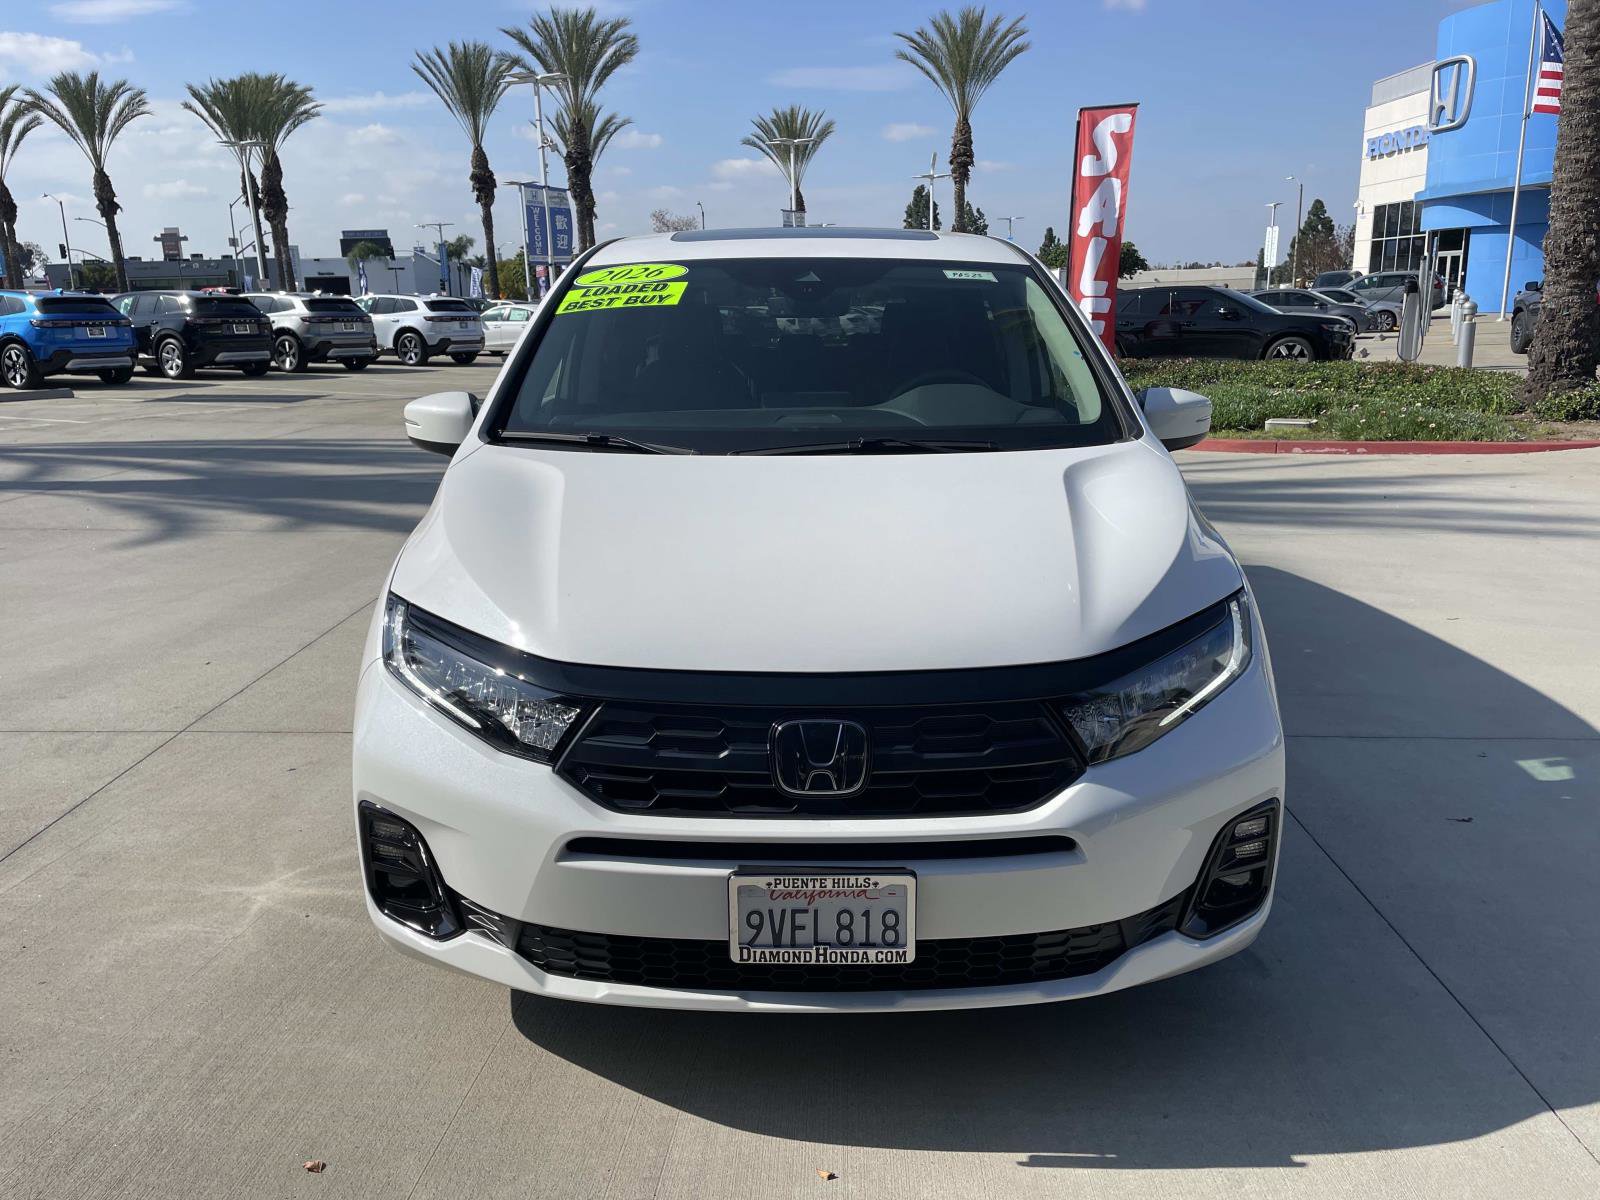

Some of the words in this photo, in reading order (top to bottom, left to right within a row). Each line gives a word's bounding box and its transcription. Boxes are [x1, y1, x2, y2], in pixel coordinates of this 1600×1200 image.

[530, 206, 543, 255] WELCOME
[1077, 113, 1132, 336] SALE
[589, 266, 668, 283] 2026
[581, 282, 669, 298] LOADED
[562, 297, 621, 312] BEST
[622, 294, 674, 305] BUY
[774, 878, 827, 889] PUENTE
[831, 878, 872, 889] HILLS
[769, 888, 880, 905] California
[745, 908, 900, 948] 9VFL818
